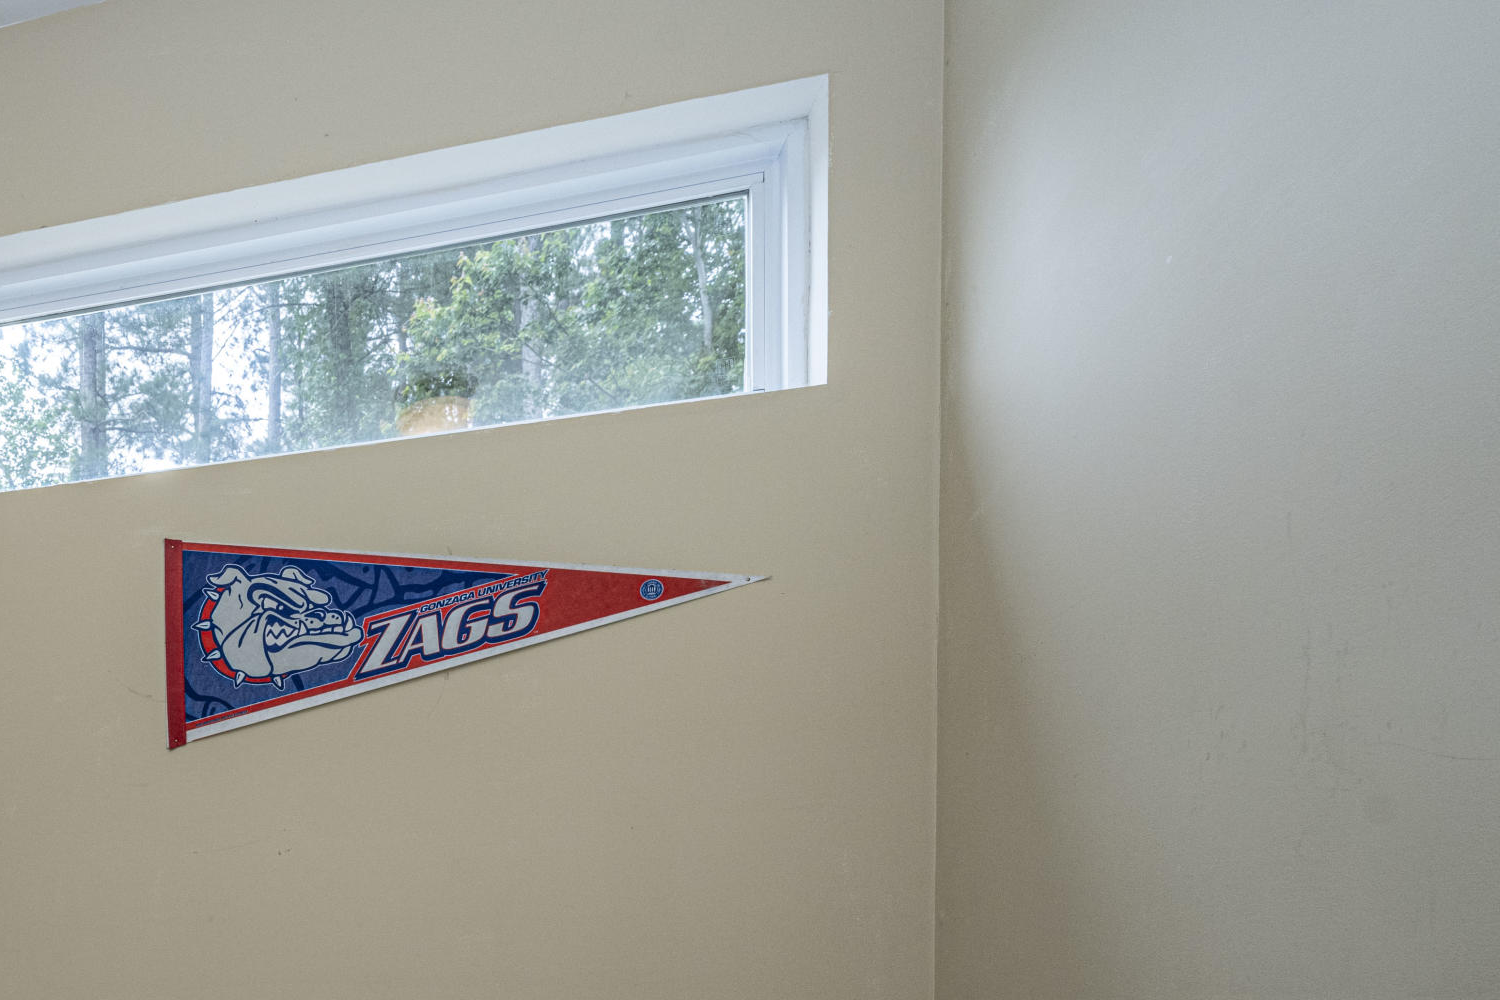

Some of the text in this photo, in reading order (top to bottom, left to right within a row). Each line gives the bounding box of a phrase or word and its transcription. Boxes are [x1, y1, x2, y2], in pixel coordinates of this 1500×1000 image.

[420, 569, 550, 613] GONZAGA UNIVERSITY
[354, 581, 548, 681] ZAGS
